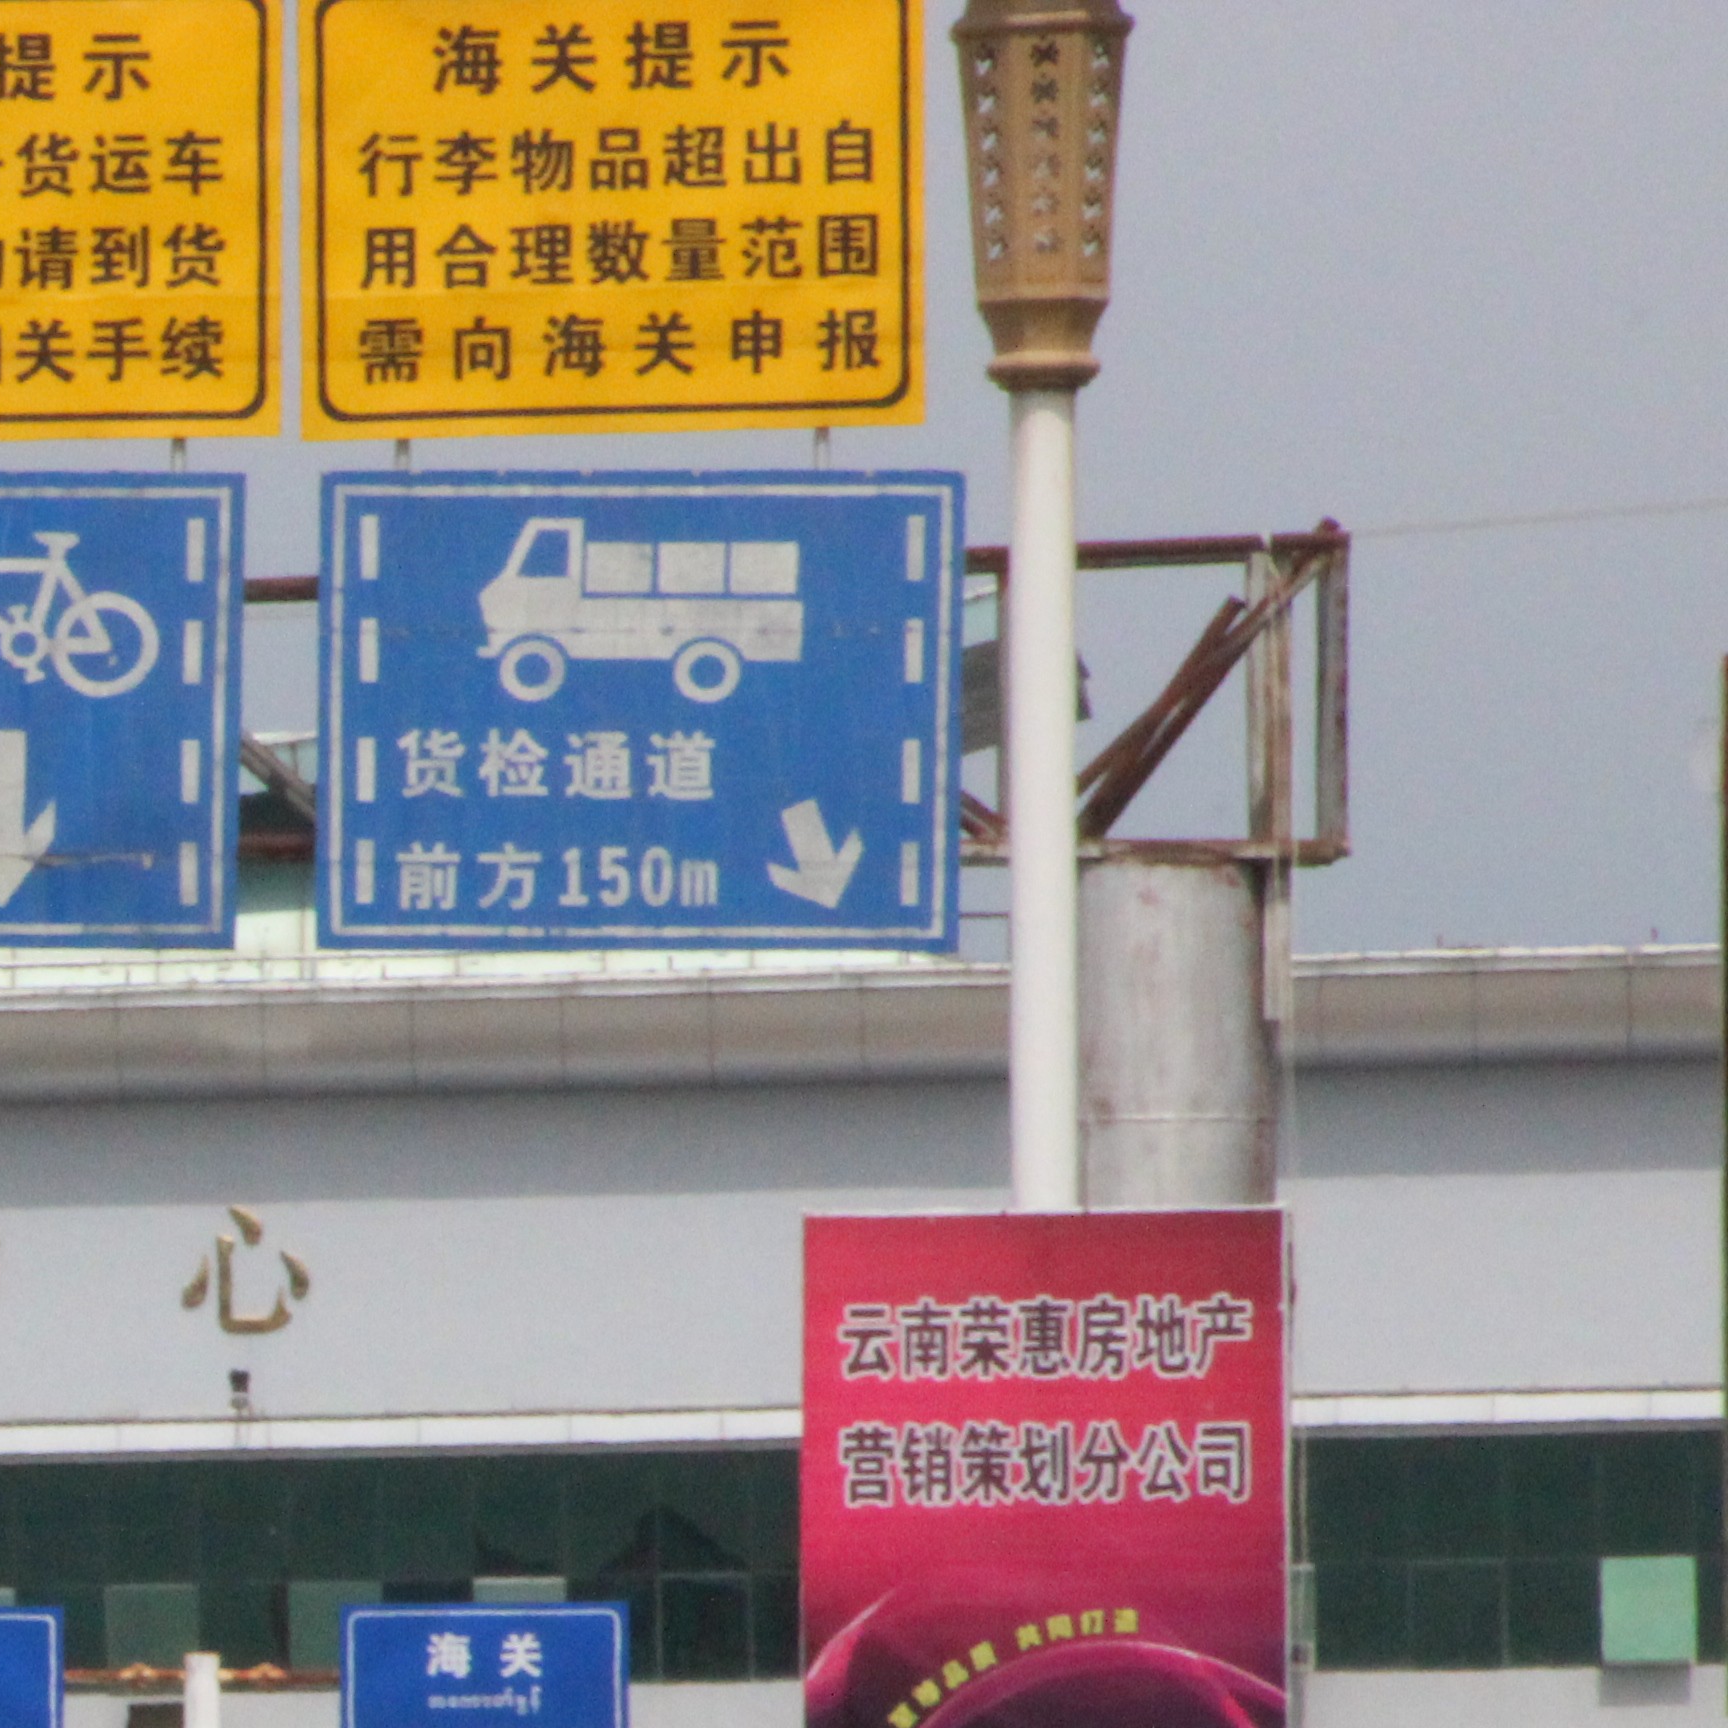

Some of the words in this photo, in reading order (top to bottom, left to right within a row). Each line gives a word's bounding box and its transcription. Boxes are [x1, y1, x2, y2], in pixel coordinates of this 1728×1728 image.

[433, 20, 791, 96] 海关提示
[360, 118, 875, 197] 行李物品超出自
[360, 213, 880, 290] 用合理数量范围
[360, 311, 880, 382] 需向海关申报
[399, 728, 717, 800] 货检通道
[396, 842, 719, 910] 前方150m
[838, 1295, 1252, 1379] 云南荣惠房地产
[839, 1420, 1252, 1505] 营销策划分公司
[427, 1632, 541, 1678] 海关
